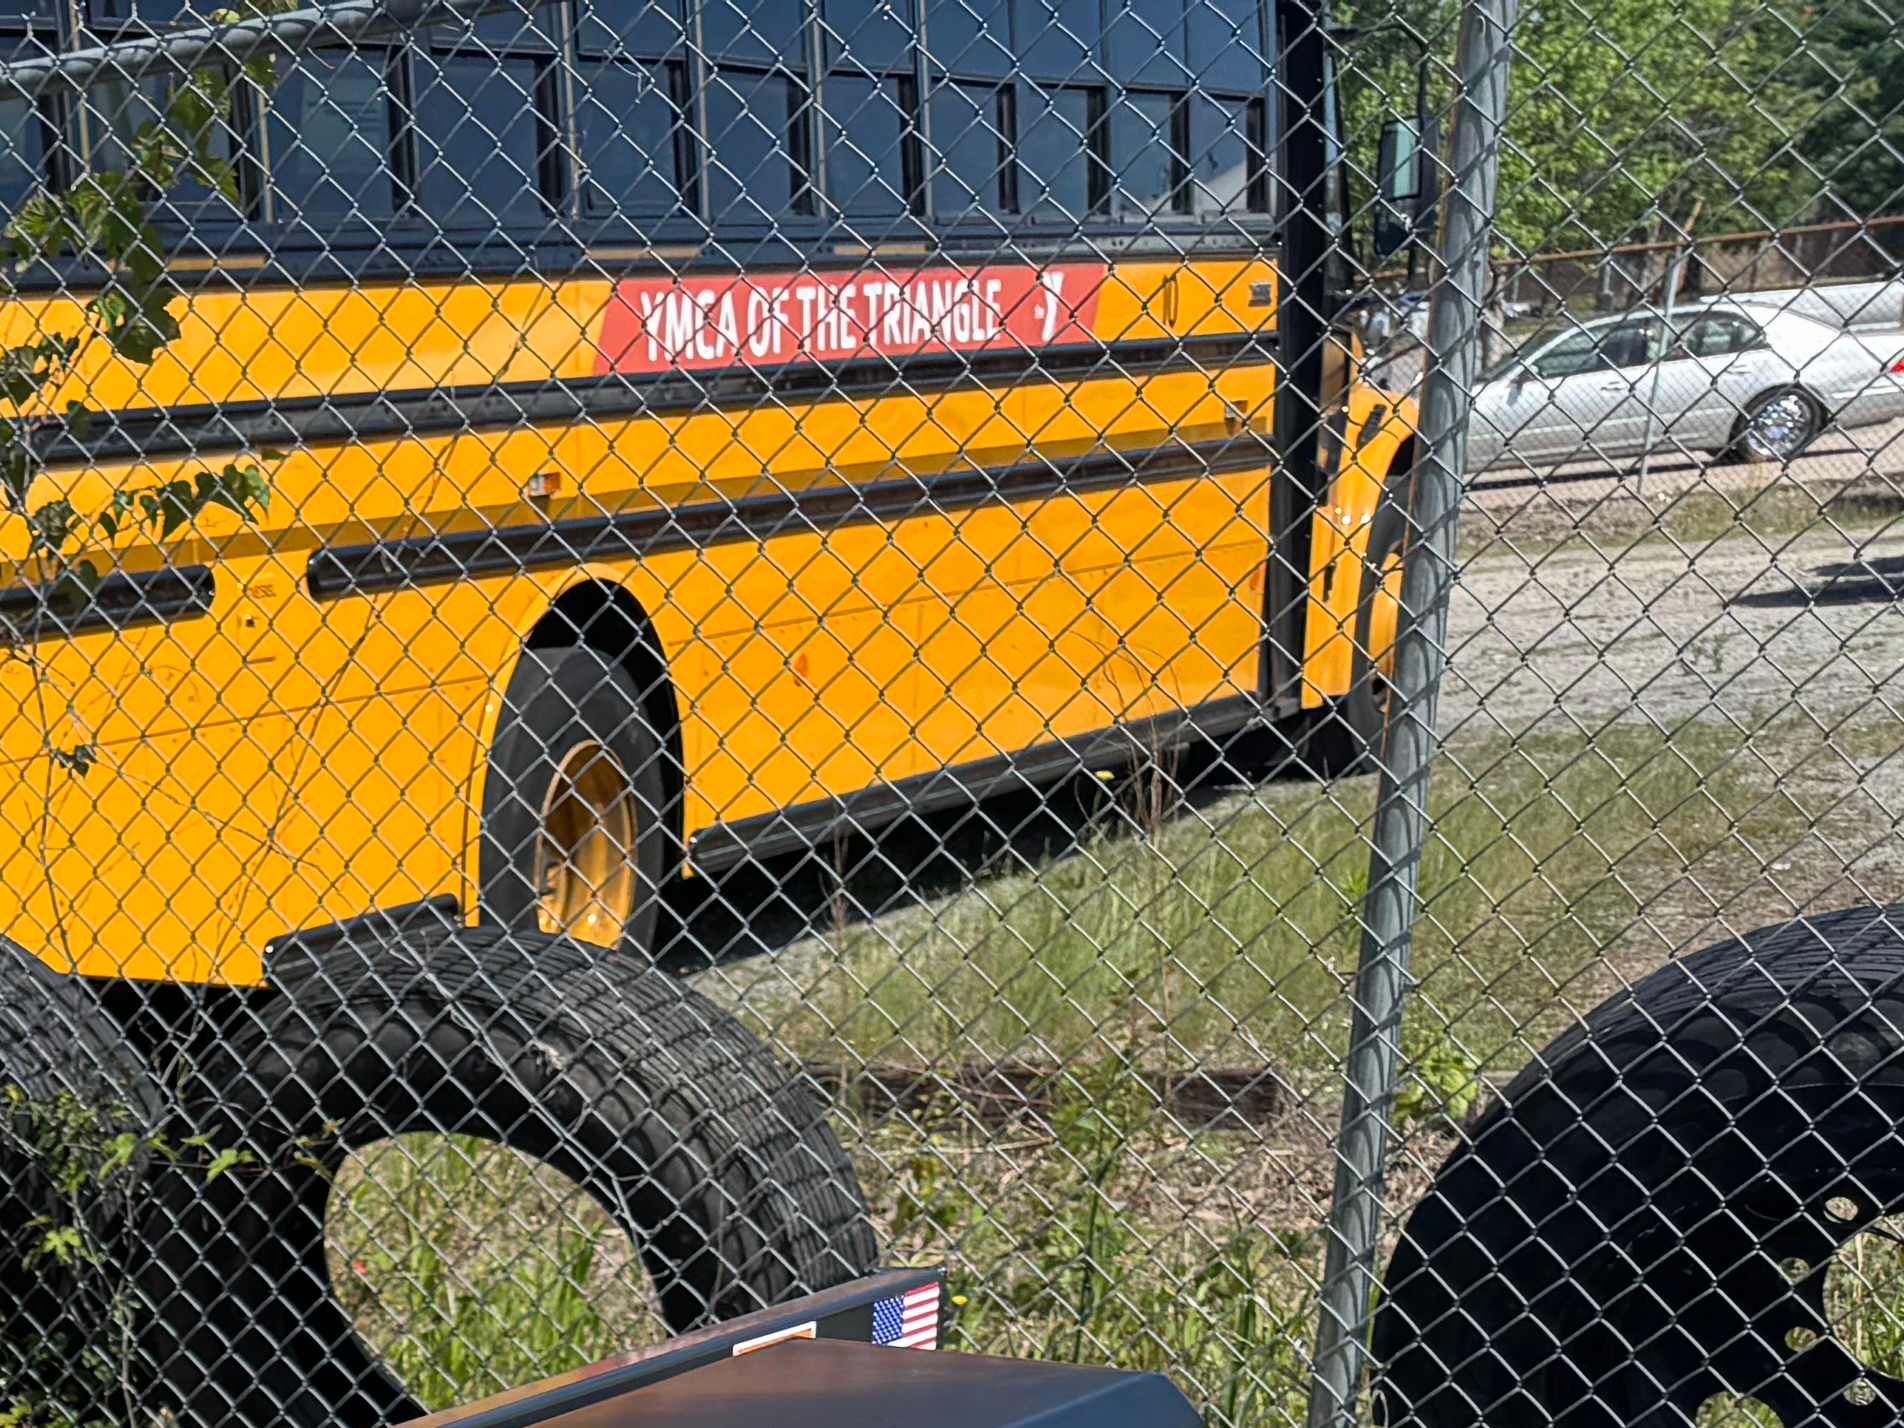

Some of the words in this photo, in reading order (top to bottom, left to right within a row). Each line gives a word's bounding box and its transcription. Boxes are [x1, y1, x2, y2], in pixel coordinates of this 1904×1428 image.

[640, 289, 738, 362] YMCA
[748, 285, 789, 358] OF
[796, 282, 857, 351] THE
[863, 278, 1003, 345] TRIANGLE
